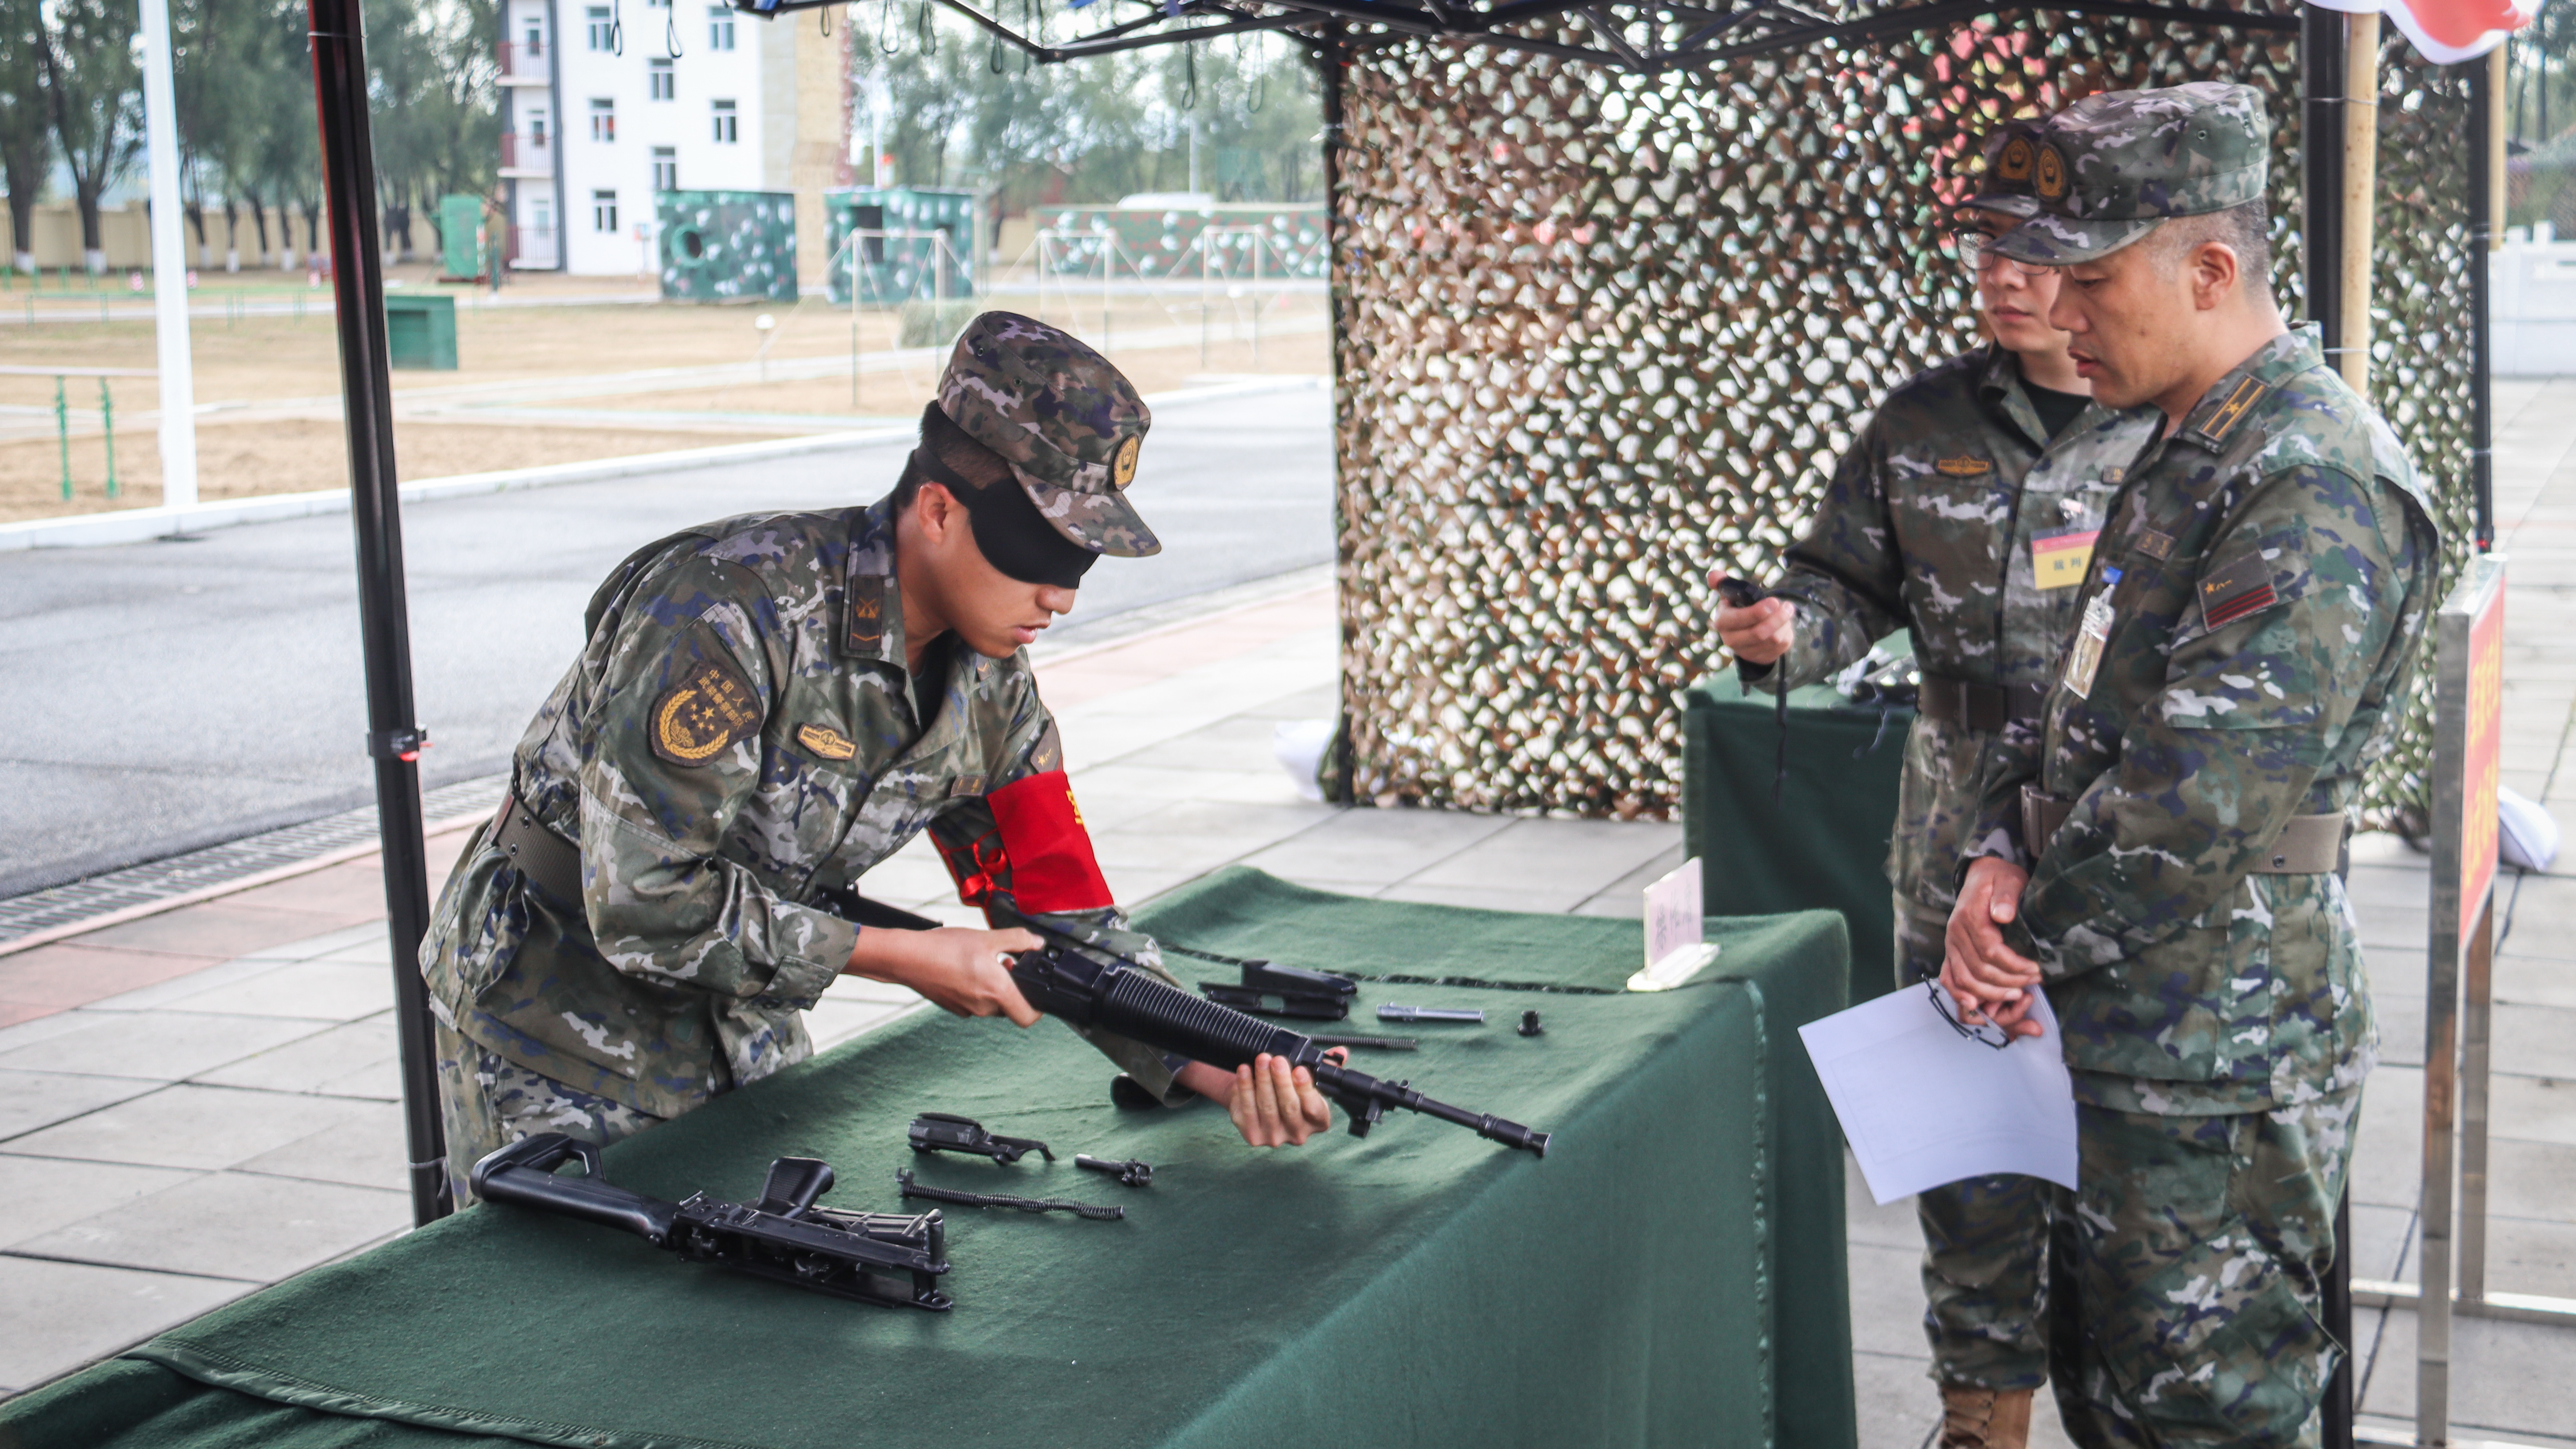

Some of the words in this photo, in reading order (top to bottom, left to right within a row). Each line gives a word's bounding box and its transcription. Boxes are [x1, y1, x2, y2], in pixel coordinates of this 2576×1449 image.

[698, 676, 744, 730] 武装警察部队
[709, 669, 755, 723] 中国人民
